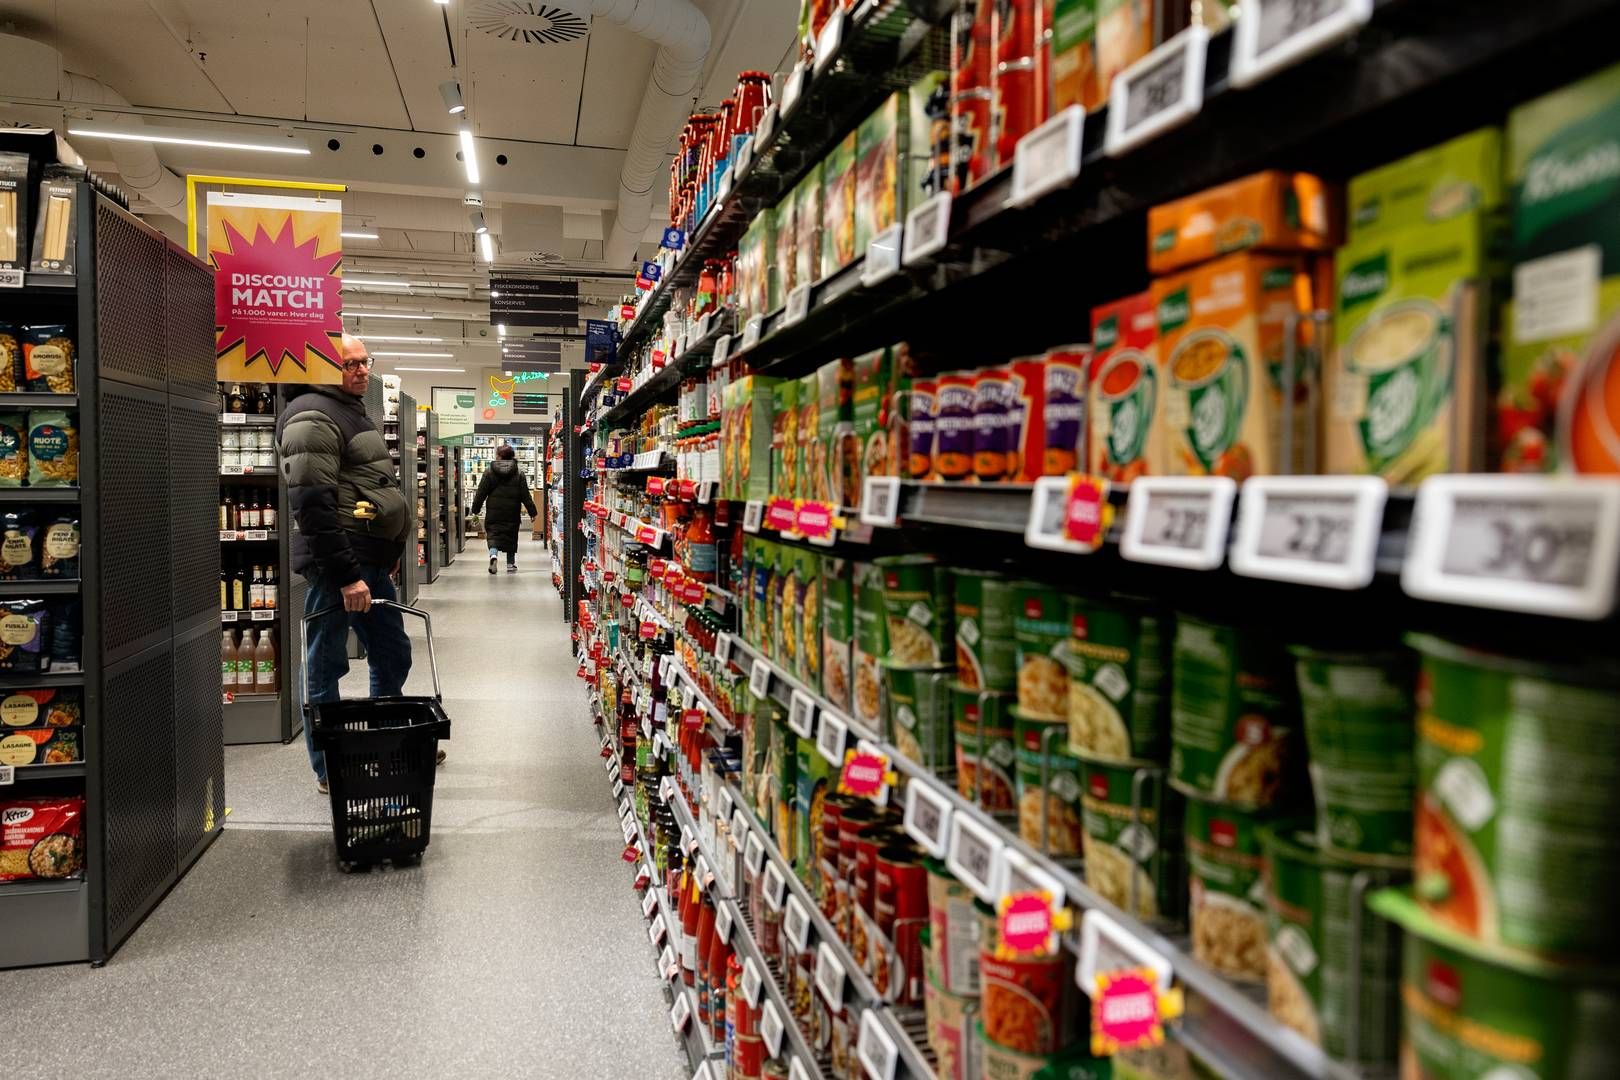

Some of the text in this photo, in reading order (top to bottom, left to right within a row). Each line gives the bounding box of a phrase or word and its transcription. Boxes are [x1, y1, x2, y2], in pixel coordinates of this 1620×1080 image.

[231, 273, 324, 289] DISCOUNT
[232, 288, 323, 309] MATCH
[309, 312, 324, 320] dag
[5, 810, 32, 822] Xtra
